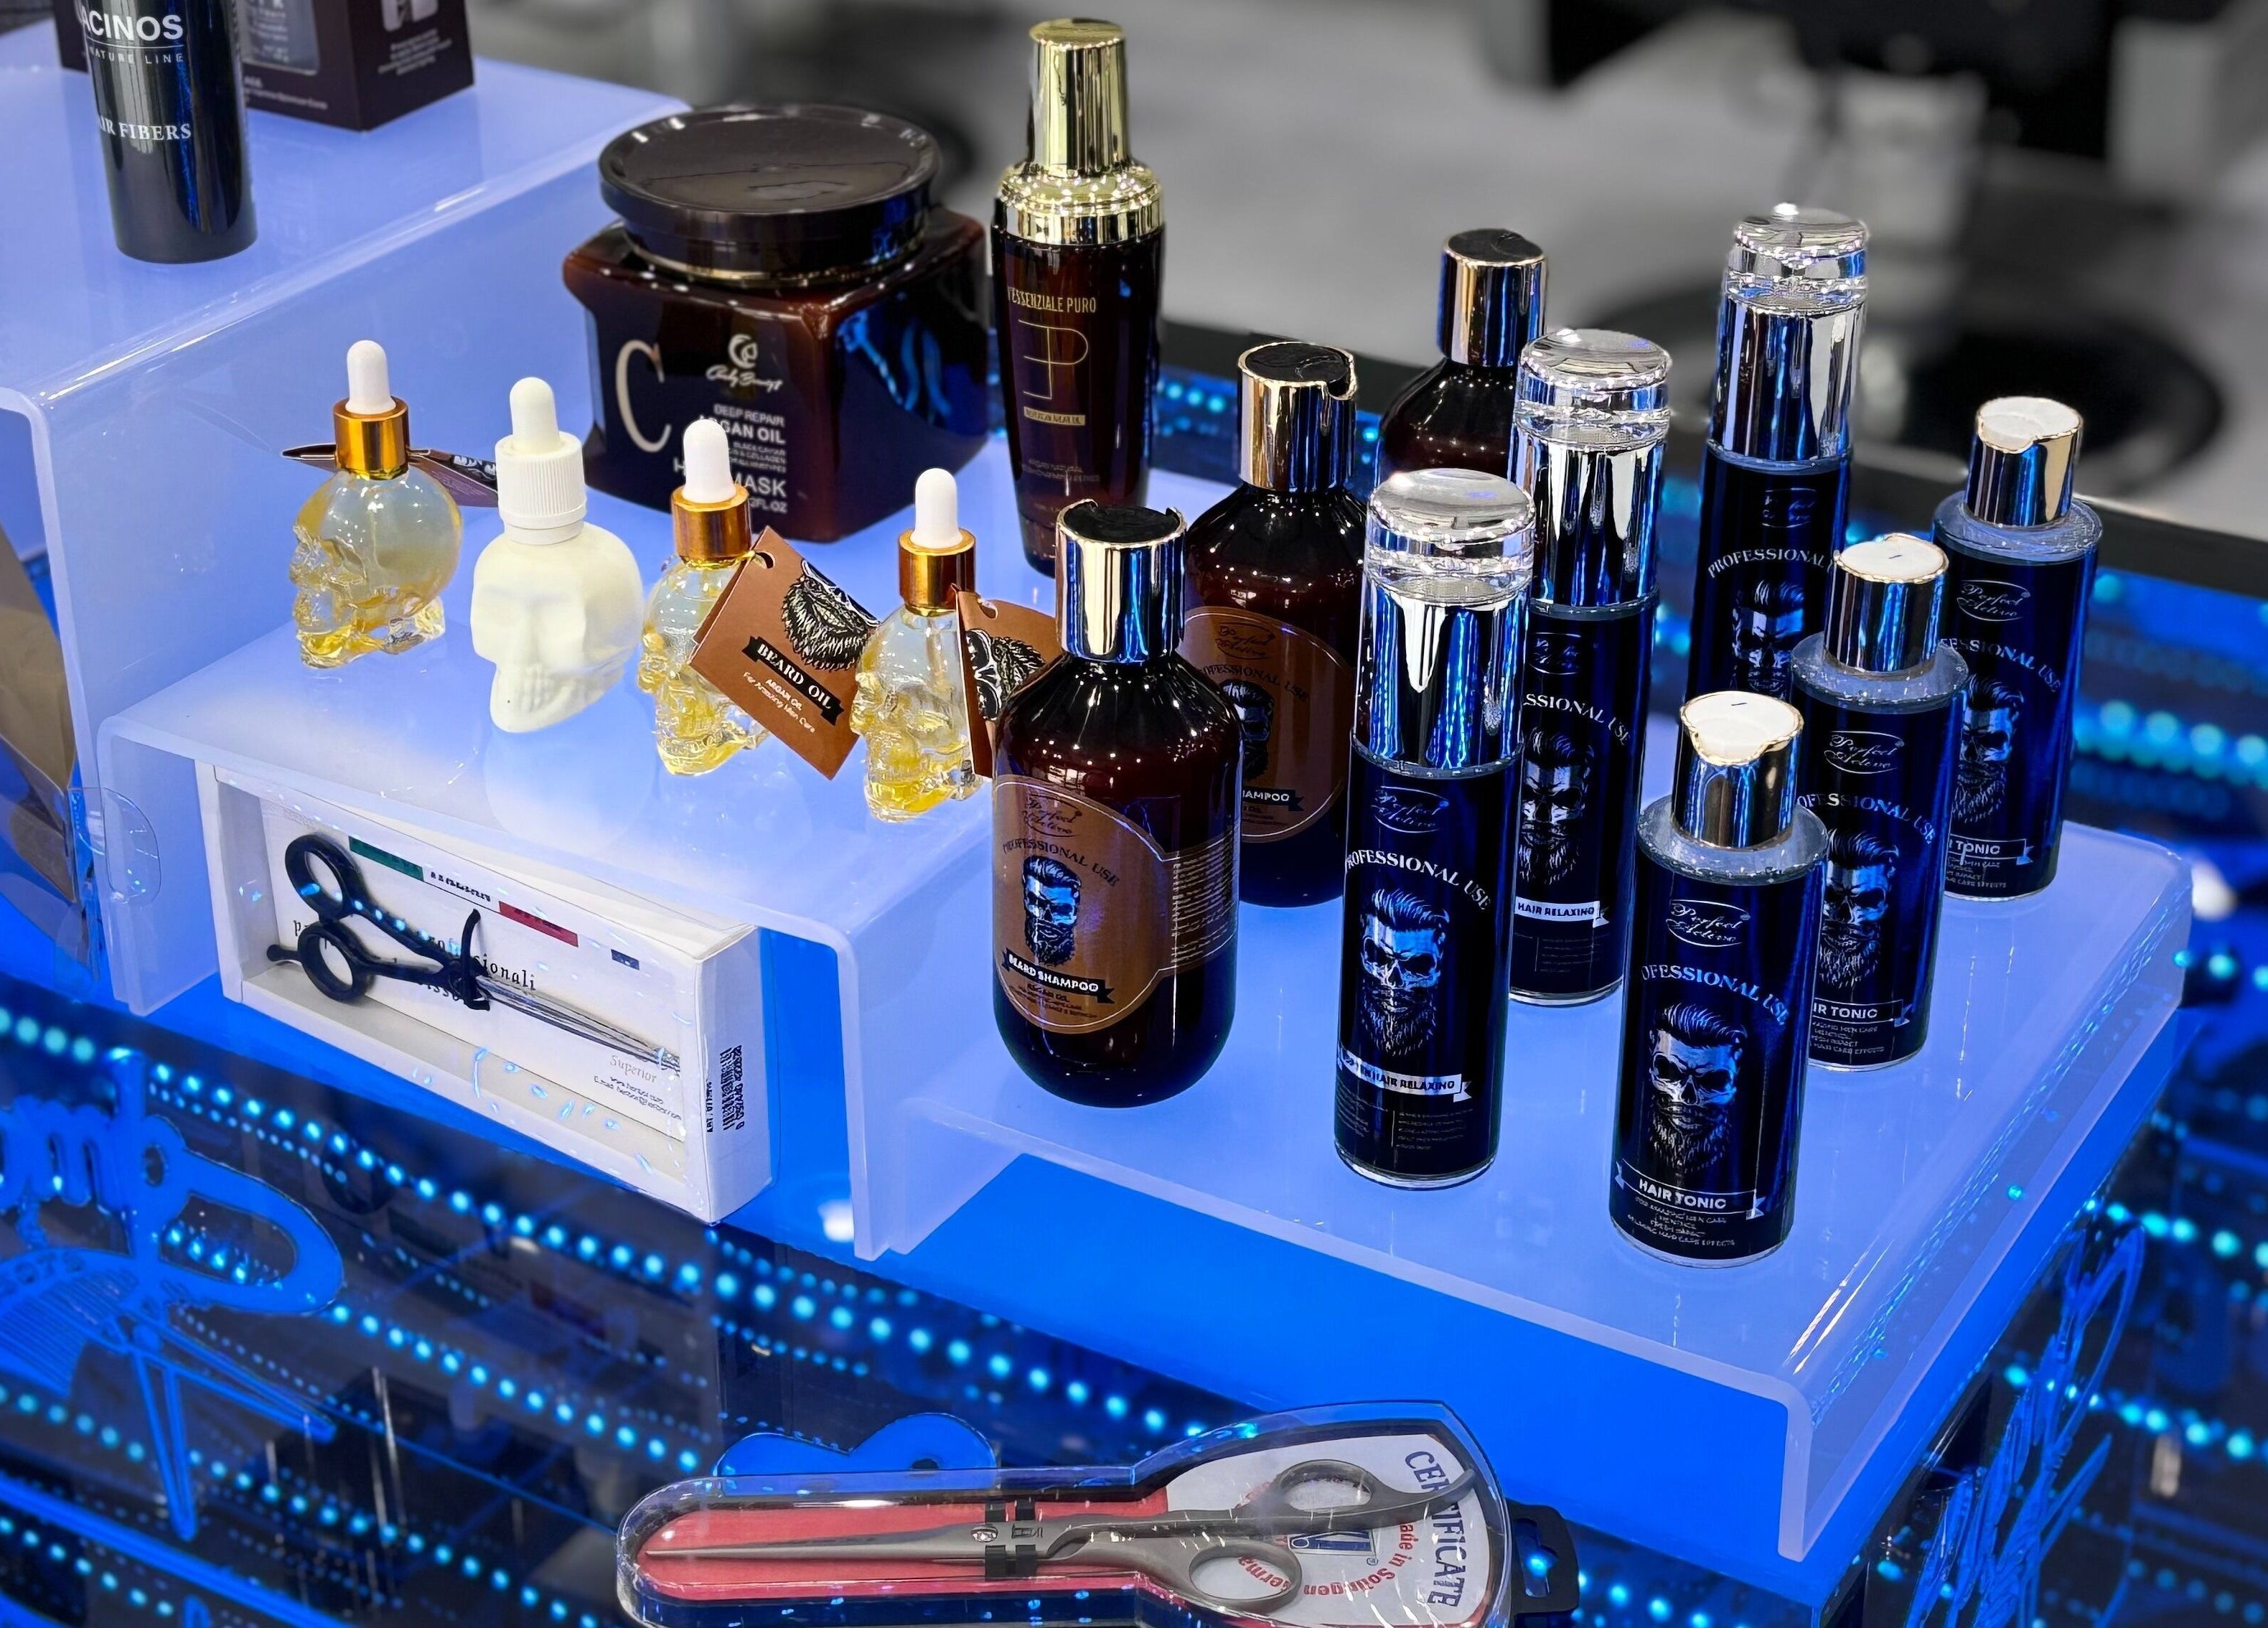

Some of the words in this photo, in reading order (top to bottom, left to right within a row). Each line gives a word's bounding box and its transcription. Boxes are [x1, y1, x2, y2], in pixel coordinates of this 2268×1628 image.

[80, 6, 184, 42] ACINOS
[145, 54, 184, 65] LINE
[118, 122, 192, 140] FIBERS
[1067, 297, 1096, 313] PURO
[713, 403, 742, 418] DEEP
[744, 411, 785, 427] REPAIR
[757, 426, 786, 445] OIL
[1708, 548, 1824, 579] PROFESSIONAL
[1939, 637, 2035, 670] FESSIONAL
[756, 643, 804, 686] BEARD
[808, 685, 832, 709] OIL
[1796, 793, 1910, 821] OFESSIONAL
[1092, 863, 1120, 887] USE
[1463, 880, 1491, 911] USE
[1517, 902, 1542, 915] HAIR
[1038, 970, 1099, 992] SHAMPOO
[1641, 964, 1759, 1002] OFESSIONAL
[1830, 1006, 1878, 1019] TONIC
[609, 1054, 657, 1084] Superior
[1639, 1179, 1672, 1202] HAIR
[1675, 1192, 1727, 1209] TONIC
[1405, 1451, 1467, 1608] CEIFICATE
[1389, 1552, 1413, 1568] in
